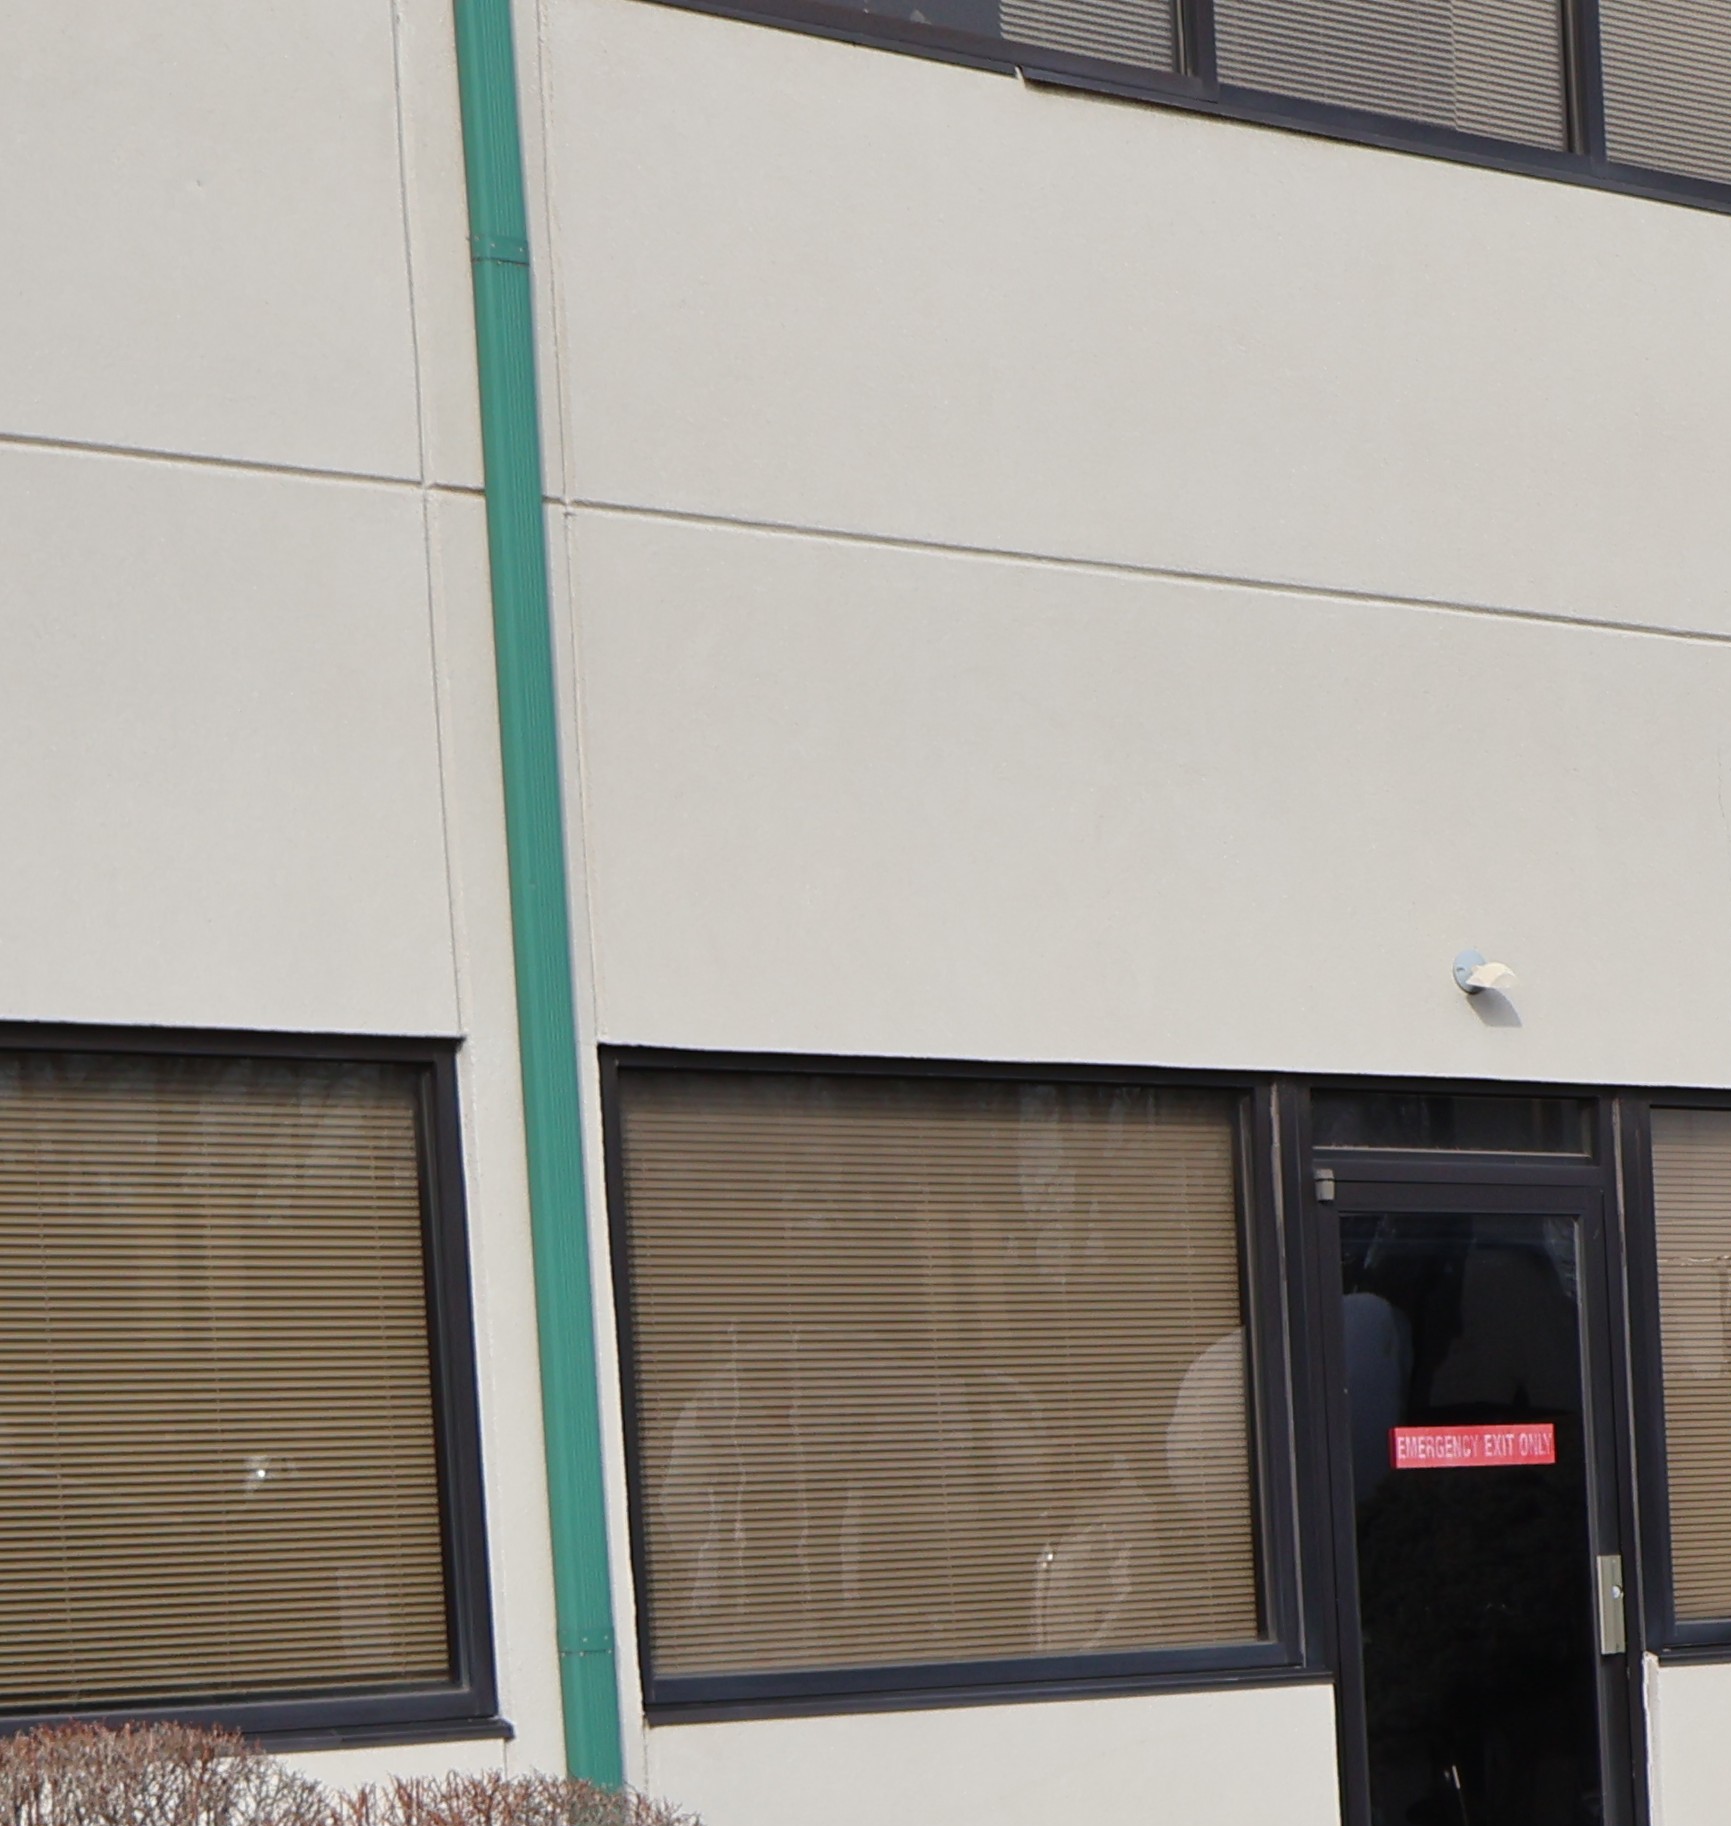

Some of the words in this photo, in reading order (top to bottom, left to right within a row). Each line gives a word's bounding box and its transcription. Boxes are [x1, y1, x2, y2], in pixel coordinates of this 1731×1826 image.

[1397, 1435, 1478, 1459] EMERGENCY
[1484, 1433, 1515, 1457] EXIT
[1519, 1432, 1552, 1456] ONLY
